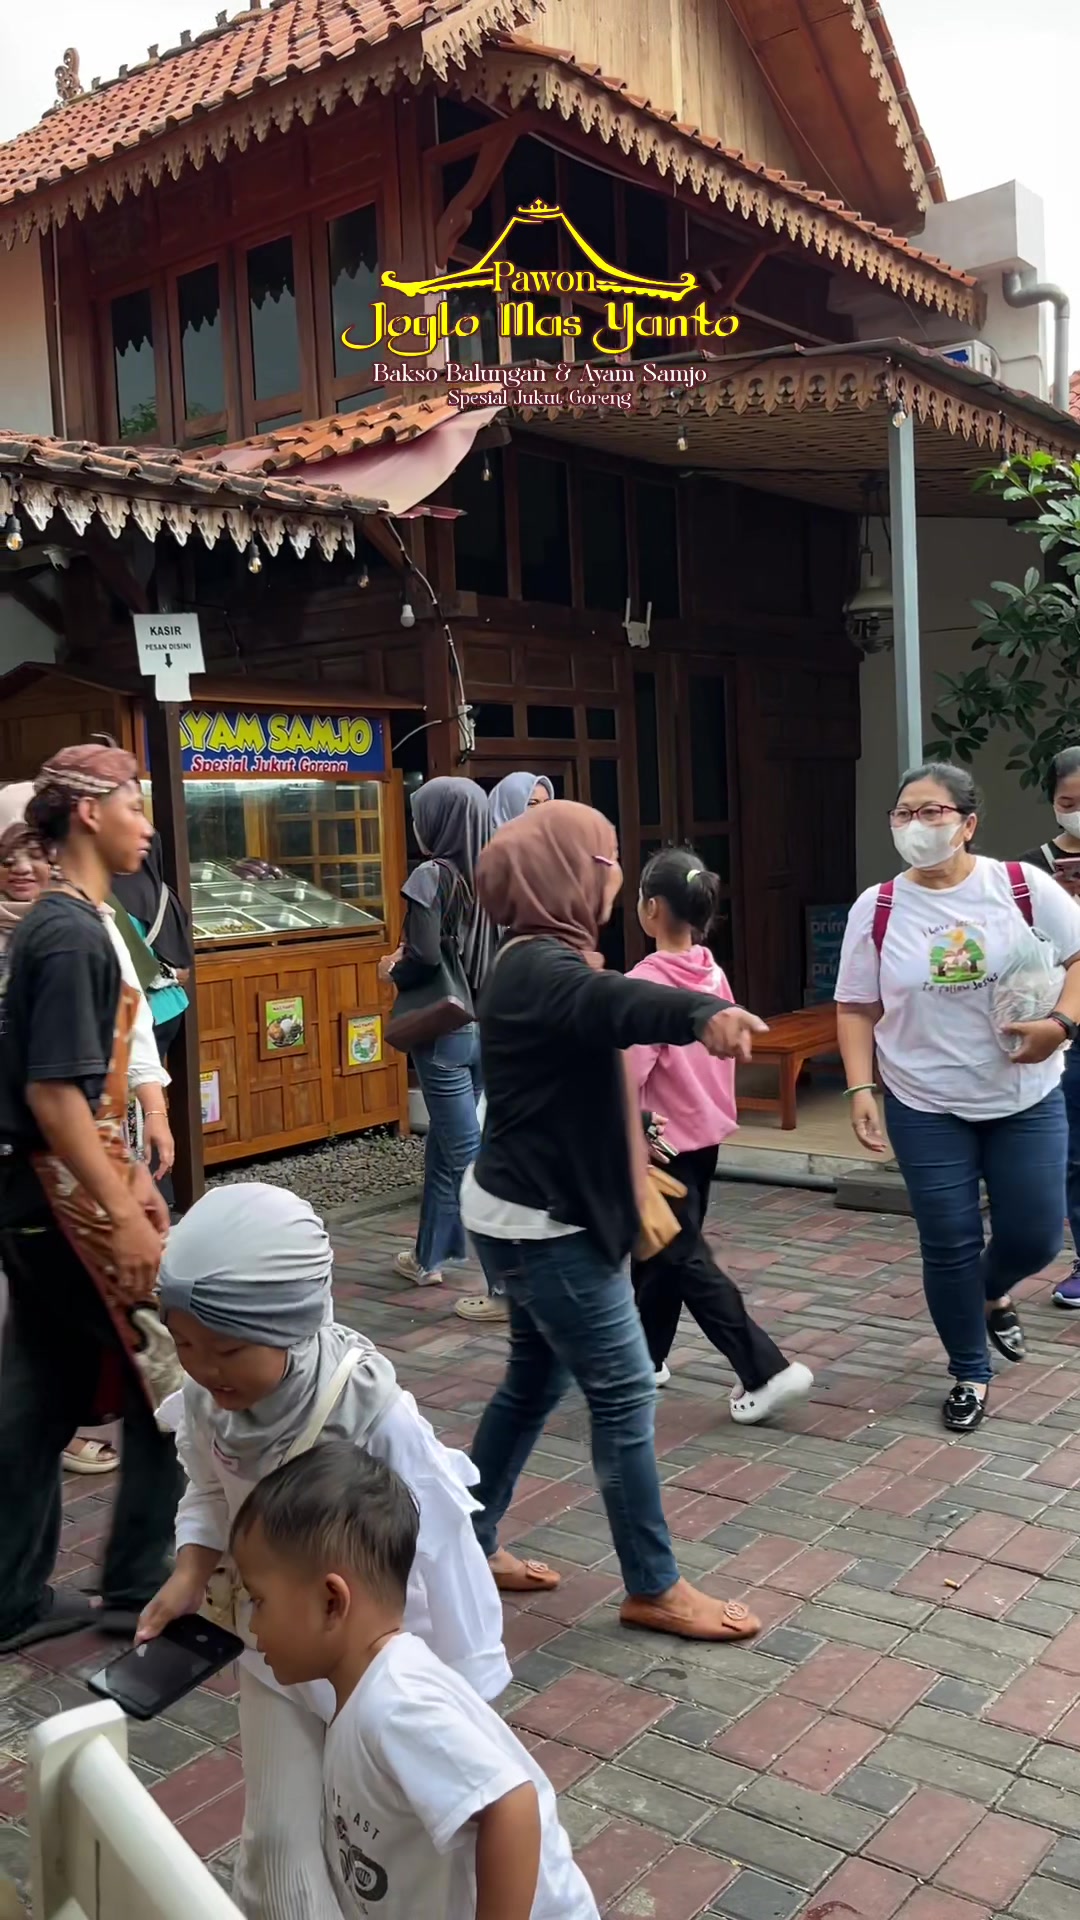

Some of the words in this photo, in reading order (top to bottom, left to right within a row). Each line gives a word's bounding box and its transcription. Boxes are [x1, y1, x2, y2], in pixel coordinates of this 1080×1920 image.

[150, 626, 182, 636] KASIR
[145, 643, 167, 651] PESAN
[268, 713, 373, 756] SAMJO
[191, 754, 248, 772] Spesial
[251, 756, 297, 772] Jukut
